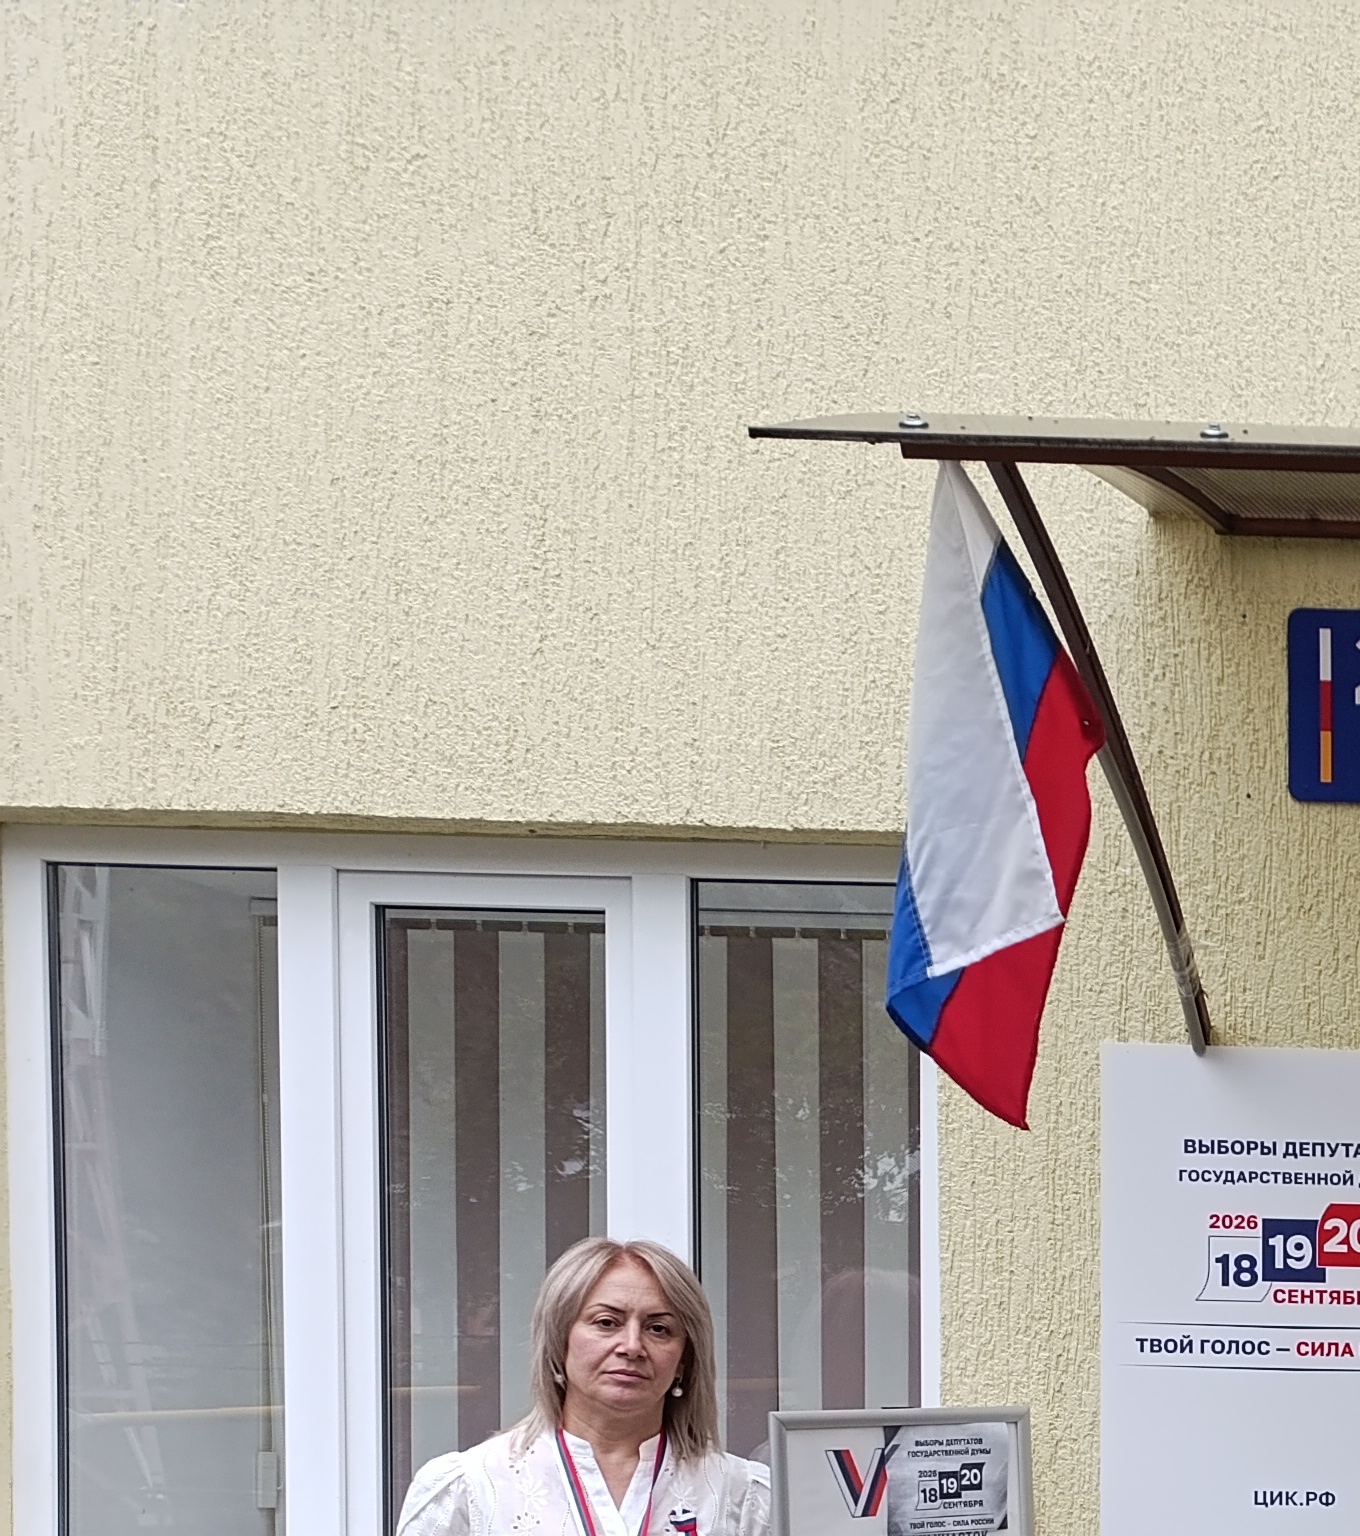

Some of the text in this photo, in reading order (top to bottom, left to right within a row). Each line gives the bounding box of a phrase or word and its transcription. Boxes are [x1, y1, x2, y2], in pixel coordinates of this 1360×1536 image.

[1184, 1139, 1276, 1156] ВЫБОРЫ
[1179, 1170, 1353, 1186] ГОСУДАРСТВЕННОЙ
[1209, 1214, 1258, 1229] 2026
[1215, 1254, 1258, 1287] 18
[1268, 1234, 1313, 1269] 19
[1136, 1335, 1193, 1353] ТВОЙ
[1200, 1340, 1270, 1355] ГОЛОС
[1297, 1342, 1354, 1357] СИЛА
[920, 1469, 980, 1503] 18 19 20
[1254, 1491, 1335, 1508] ЦИК.РФ
